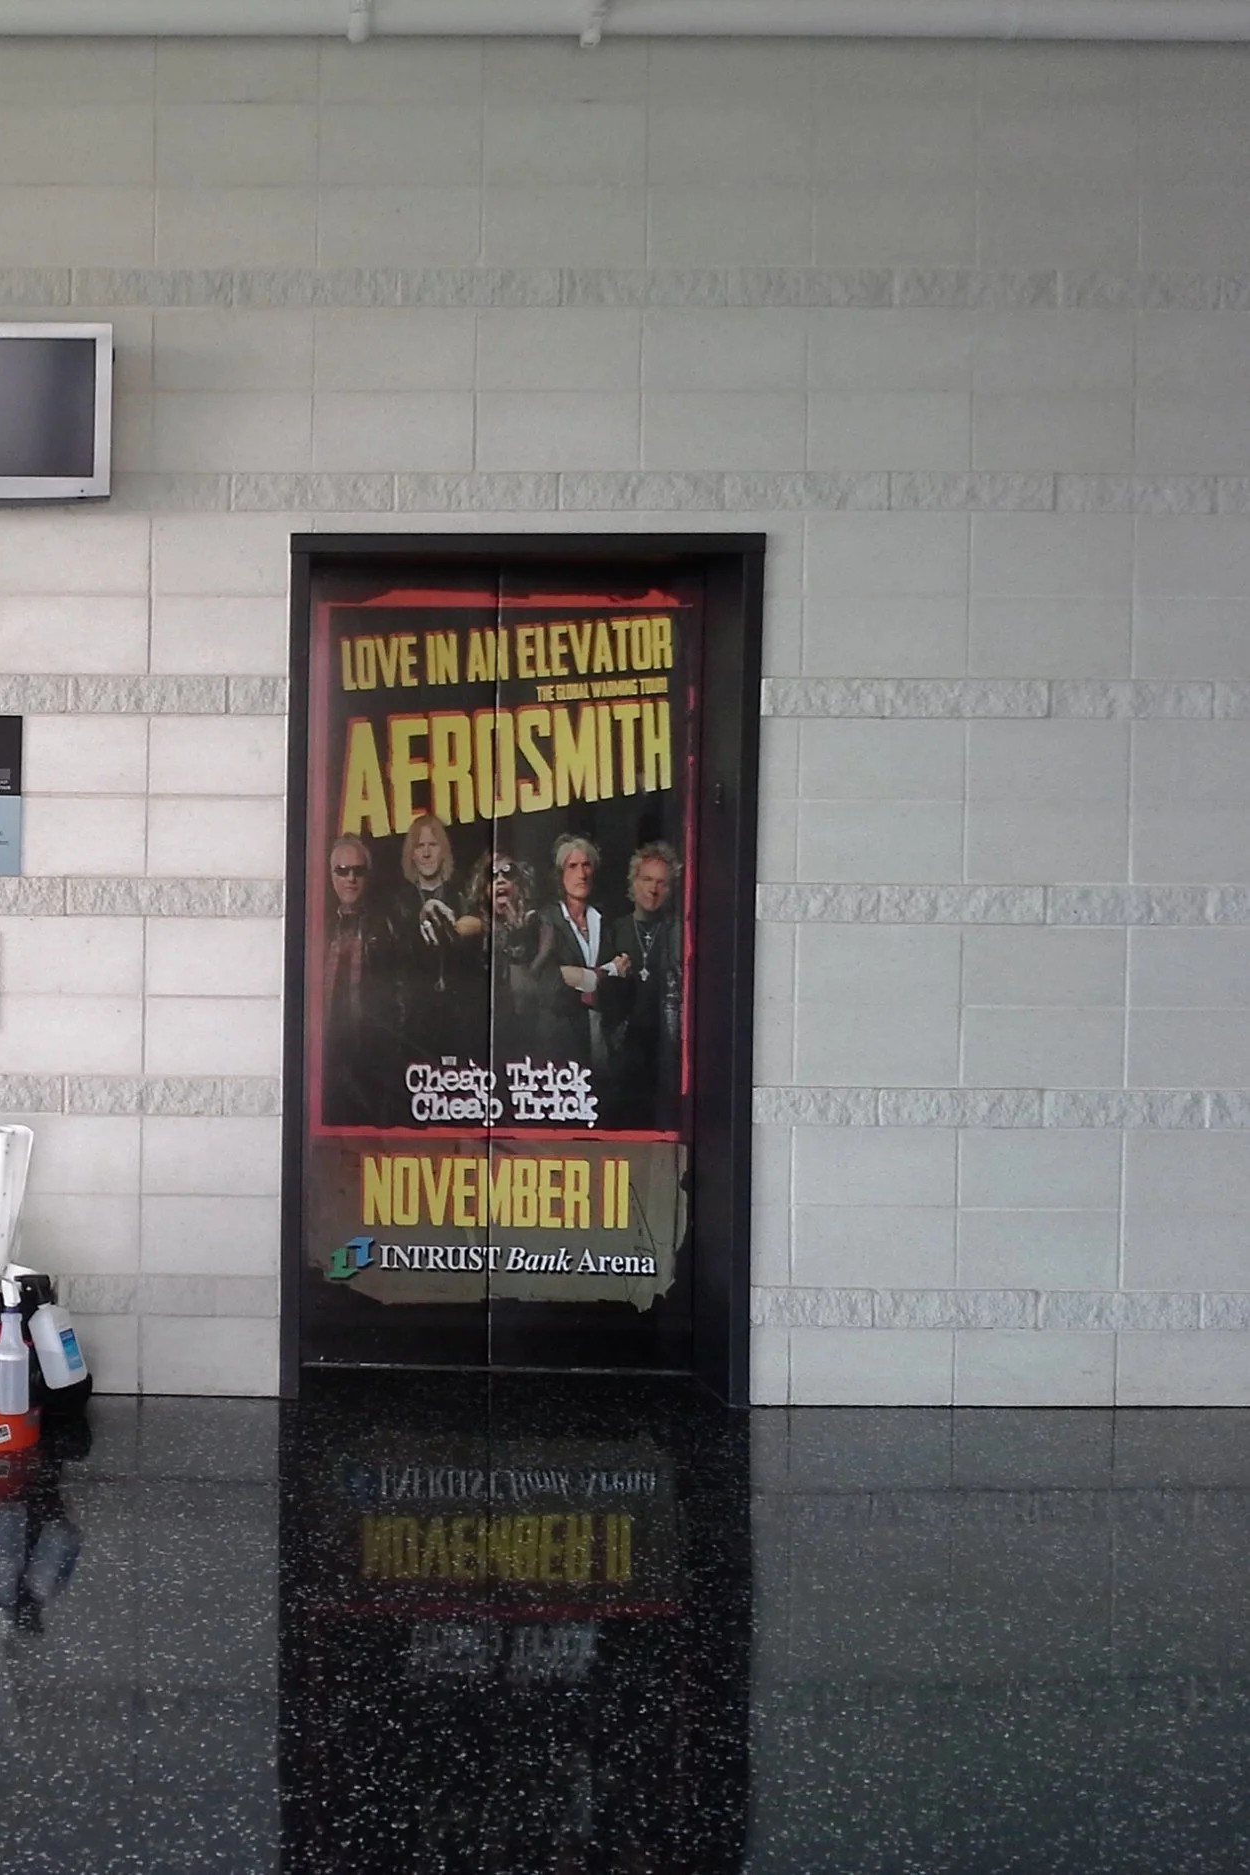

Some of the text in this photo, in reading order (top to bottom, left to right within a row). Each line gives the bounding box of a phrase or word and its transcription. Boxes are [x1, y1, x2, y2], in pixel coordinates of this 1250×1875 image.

[340, 614, 672, 690] LOVE IN AN ELEVATOR
[536, 685, 555, 702] THE
[338, 699, 673, 837] AEROSMITH
[406, 1056, 592, 1099] Cheap Trick
[412, 1091, 599, 1128] Cheap Trick
[362, 1153, 590, 1229] NOVEMBER
[379, 1245, 657, 1274] INTRUST Bank Arena
